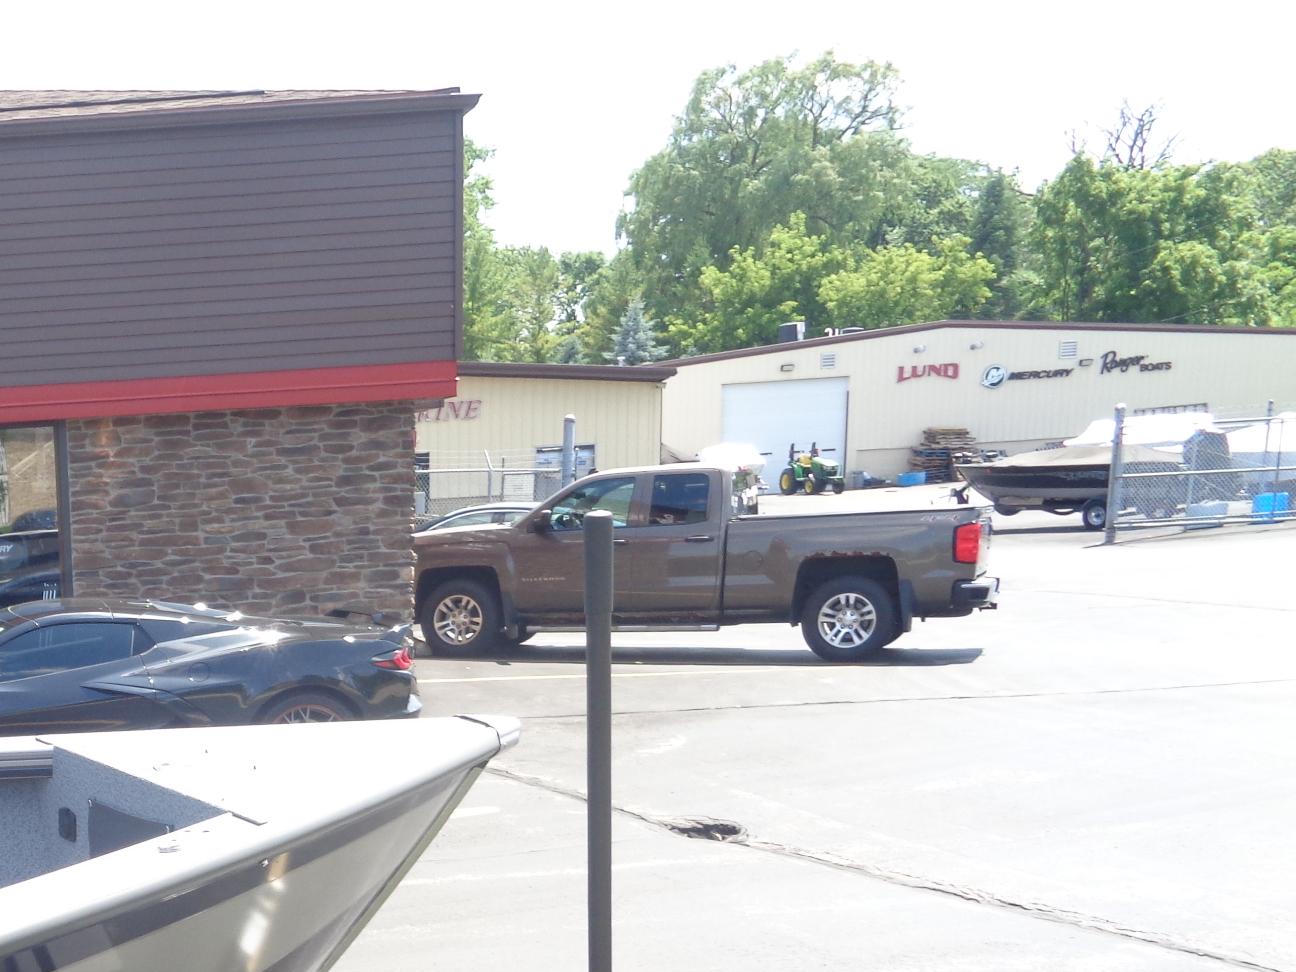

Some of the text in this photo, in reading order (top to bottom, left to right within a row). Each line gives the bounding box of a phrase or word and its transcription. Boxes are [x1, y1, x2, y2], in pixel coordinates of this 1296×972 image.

[896, 362, 960, 383] LUND
[1100, 350, 1172, 375] Ranger BOATS
[1007, 368, 1075, 381] MERCURY
